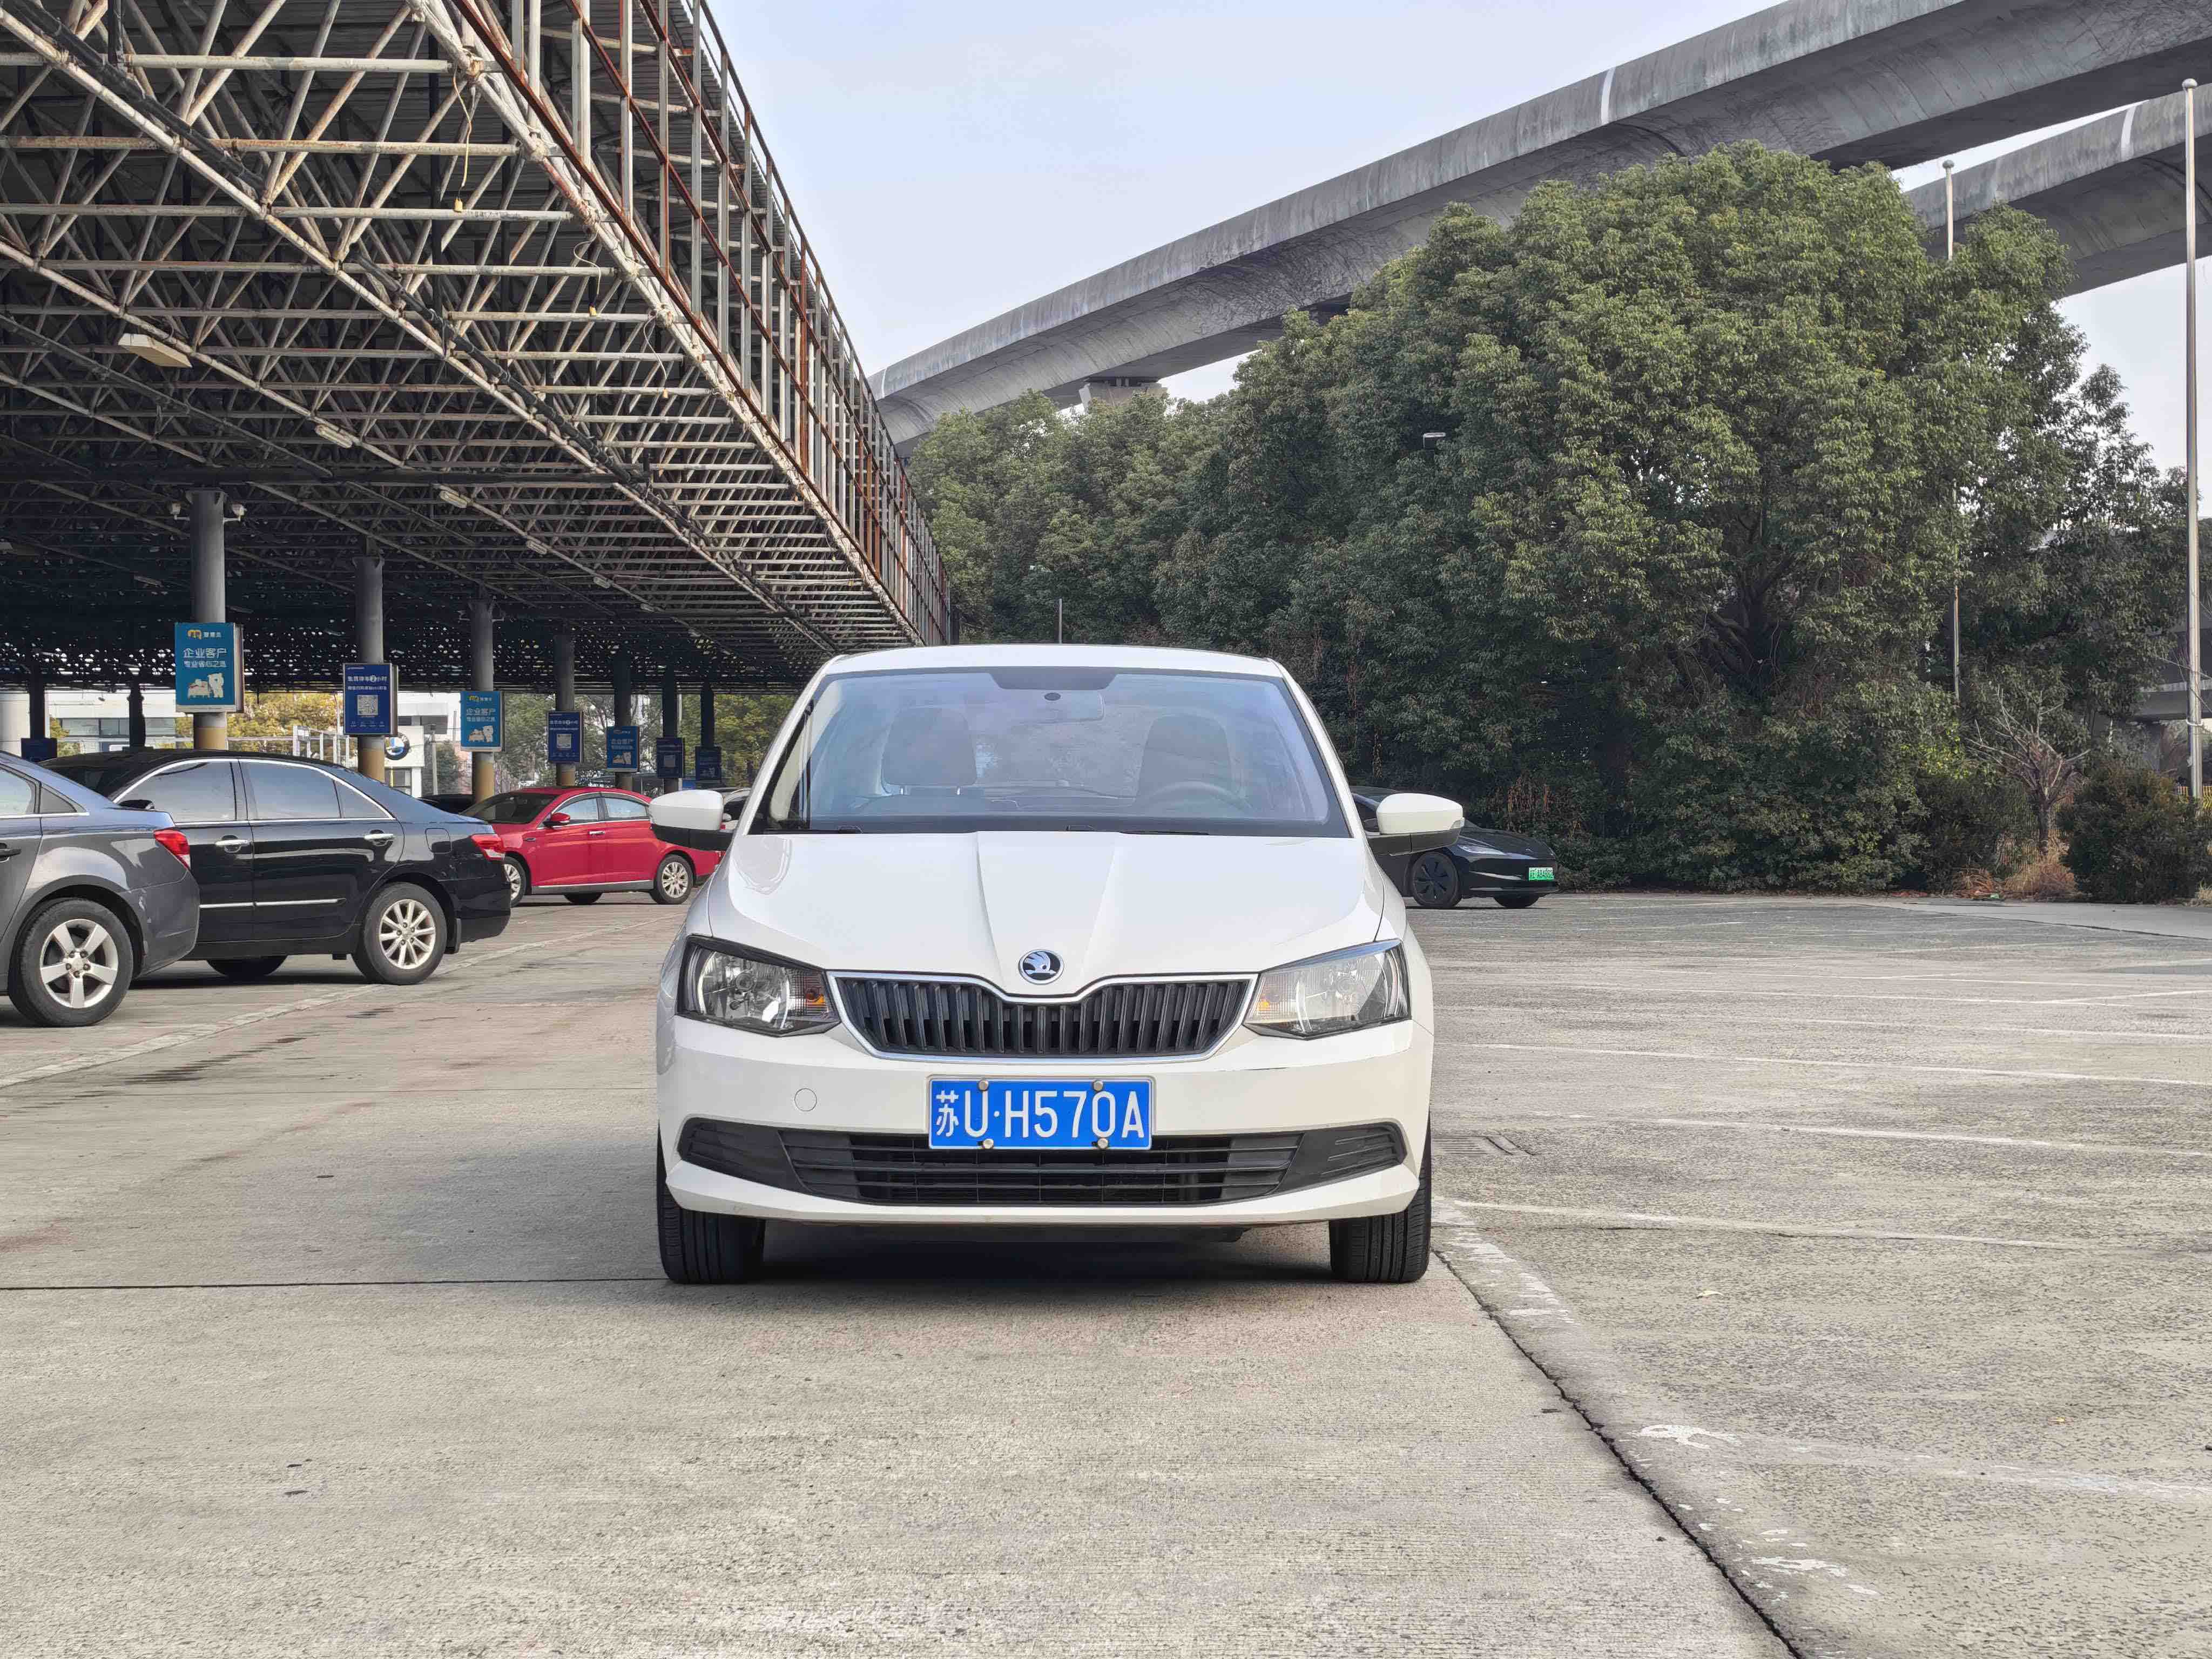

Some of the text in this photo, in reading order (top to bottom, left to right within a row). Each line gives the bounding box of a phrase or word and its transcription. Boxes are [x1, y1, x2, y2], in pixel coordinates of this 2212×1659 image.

[184, 648, 226, 658] 企业客户
[936, 1090, 1144, 1138] 苏U·H570A
